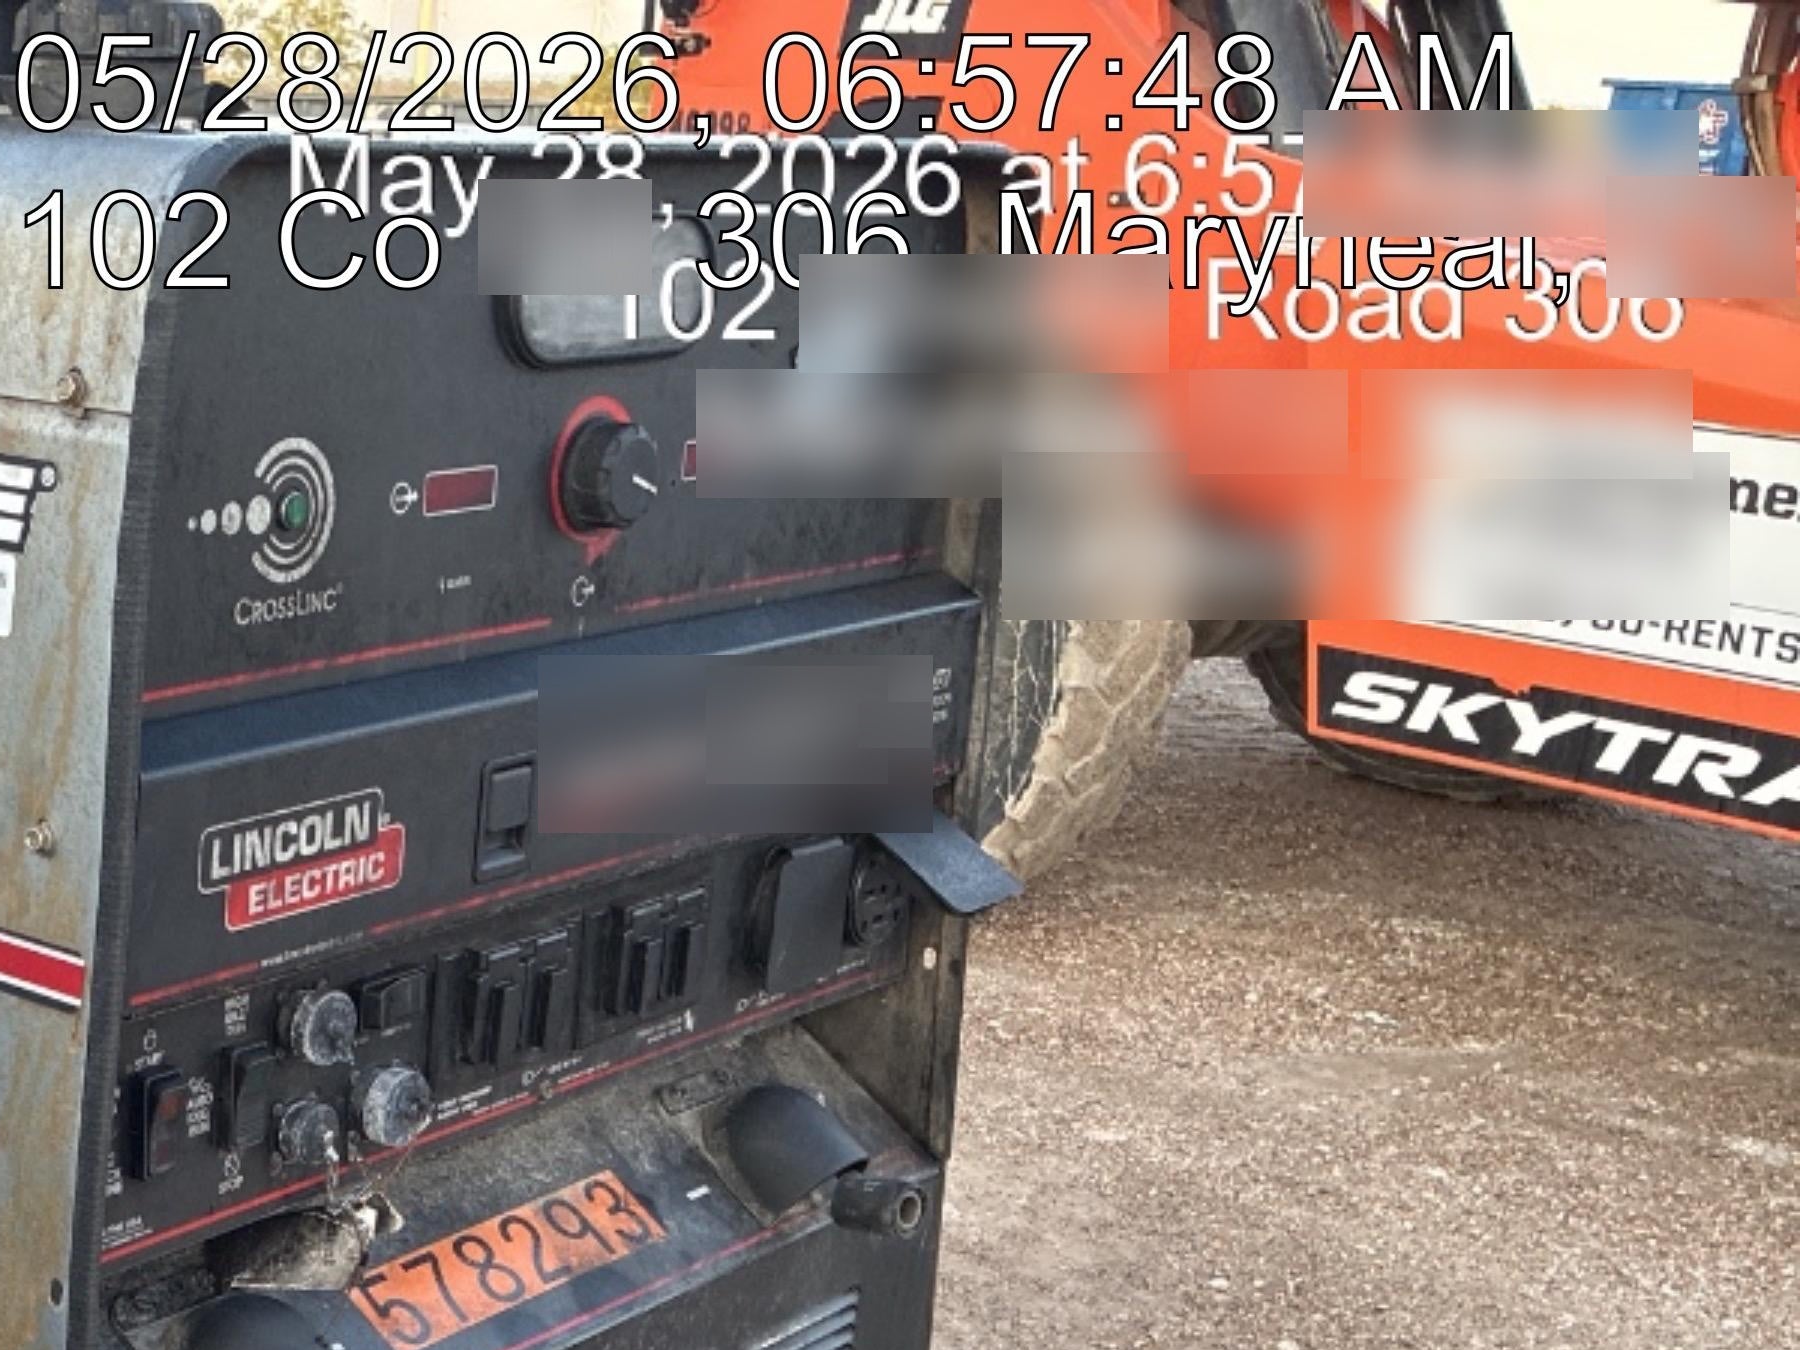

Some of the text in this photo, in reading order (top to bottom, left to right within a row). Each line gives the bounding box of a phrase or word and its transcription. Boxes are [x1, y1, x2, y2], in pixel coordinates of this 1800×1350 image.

[210, 801, 372, 879] LINCOLN
[248, 852, 385, 916] ELECTRIC
[364, 1179, 650, 1345] 578293
